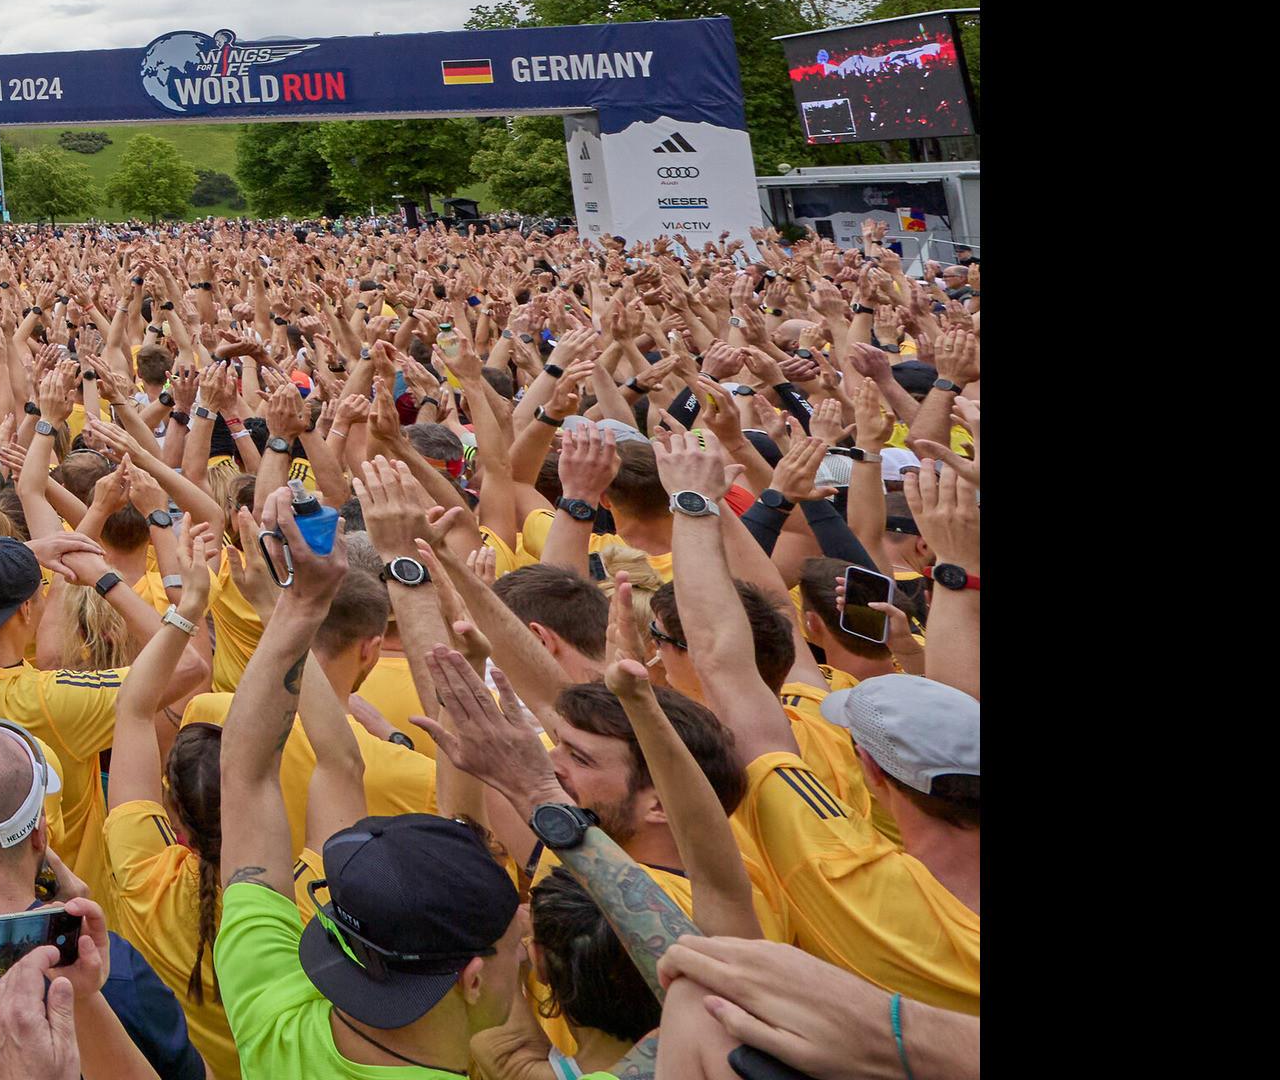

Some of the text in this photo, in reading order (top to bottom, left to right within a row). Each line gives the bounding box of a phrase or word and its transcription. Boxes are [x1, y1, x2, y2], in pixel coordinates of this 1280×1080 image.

[199, 48, 272, 64] WINGS
[210, 63, 251, 77] LIFE
[511, 51, 653, 83] GERMANY
[9, 77, 63, 101] 2024
[174, 72, 345, 105] WORLD RUN
[657, 197, 708, 206] KIESER
[662, 221, 711, 230] VIACTIV
[6, 826, 27, 843] HELLY
